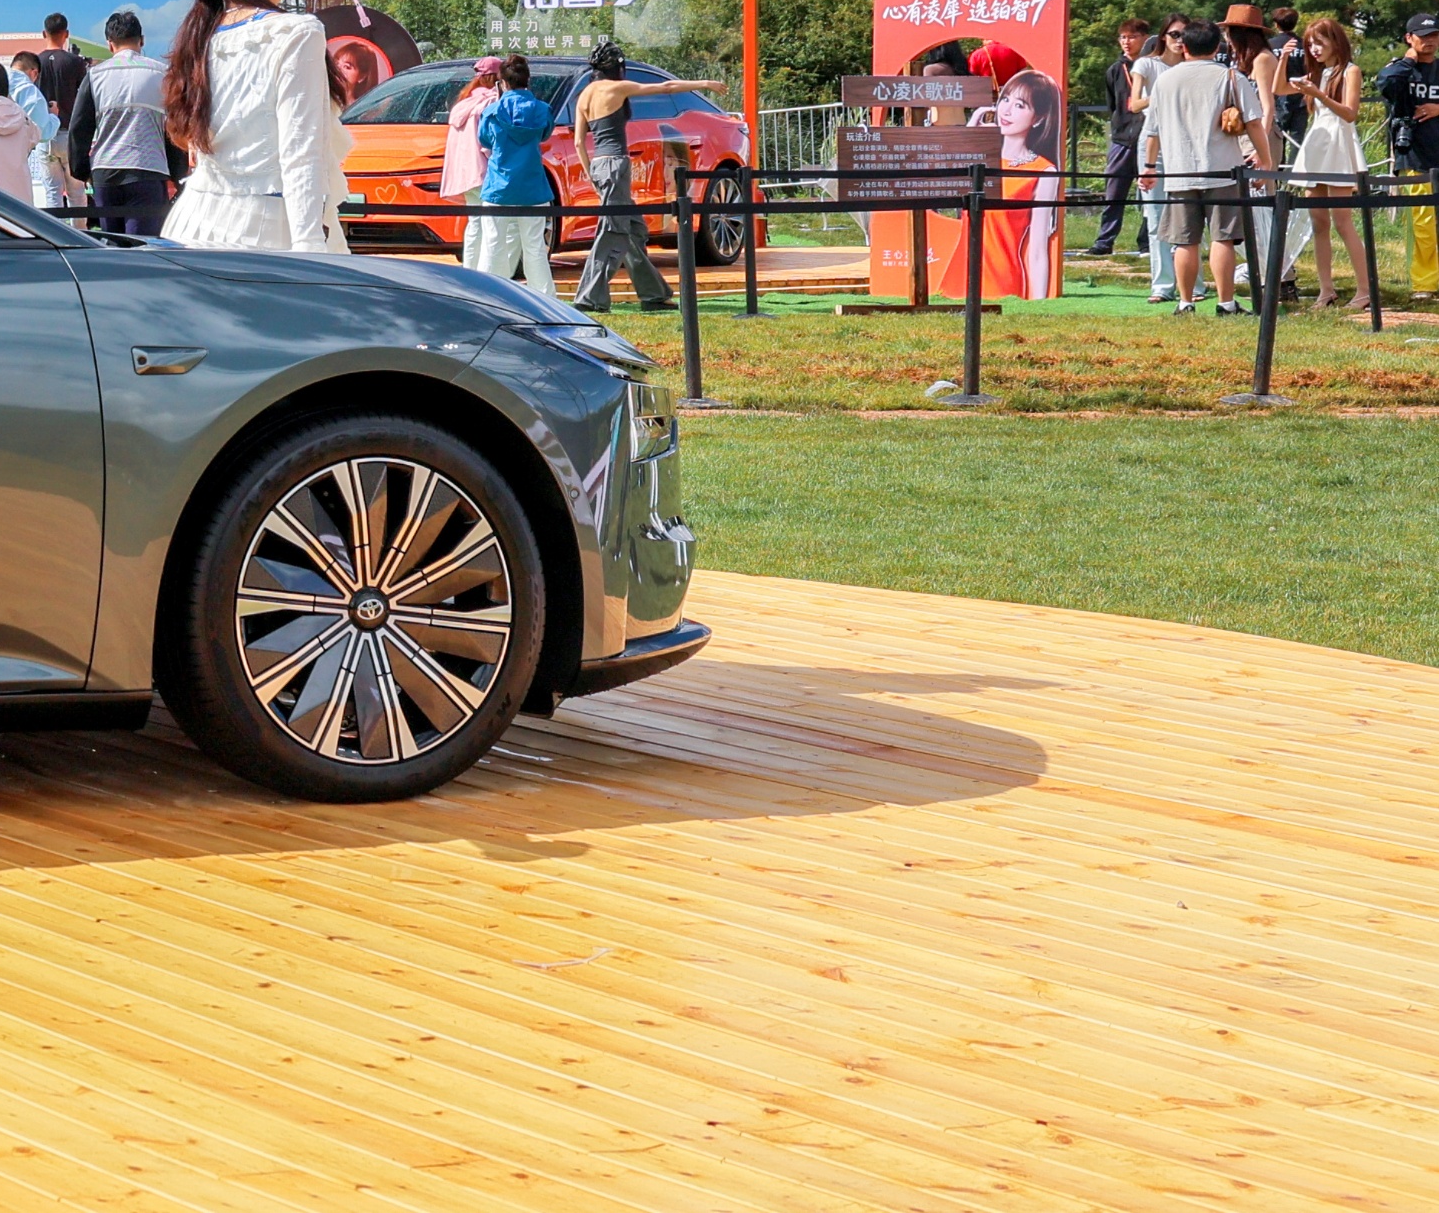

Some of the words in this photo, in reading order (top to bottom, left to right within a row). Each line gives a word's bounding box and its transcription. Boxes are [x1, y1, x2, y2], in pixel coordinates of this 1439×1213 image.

[490, 20, 539, 33] 用实力
[872, 81, 963, 102] 心凌K歌站
[846, 132, 881, 142] 玩法介绍
